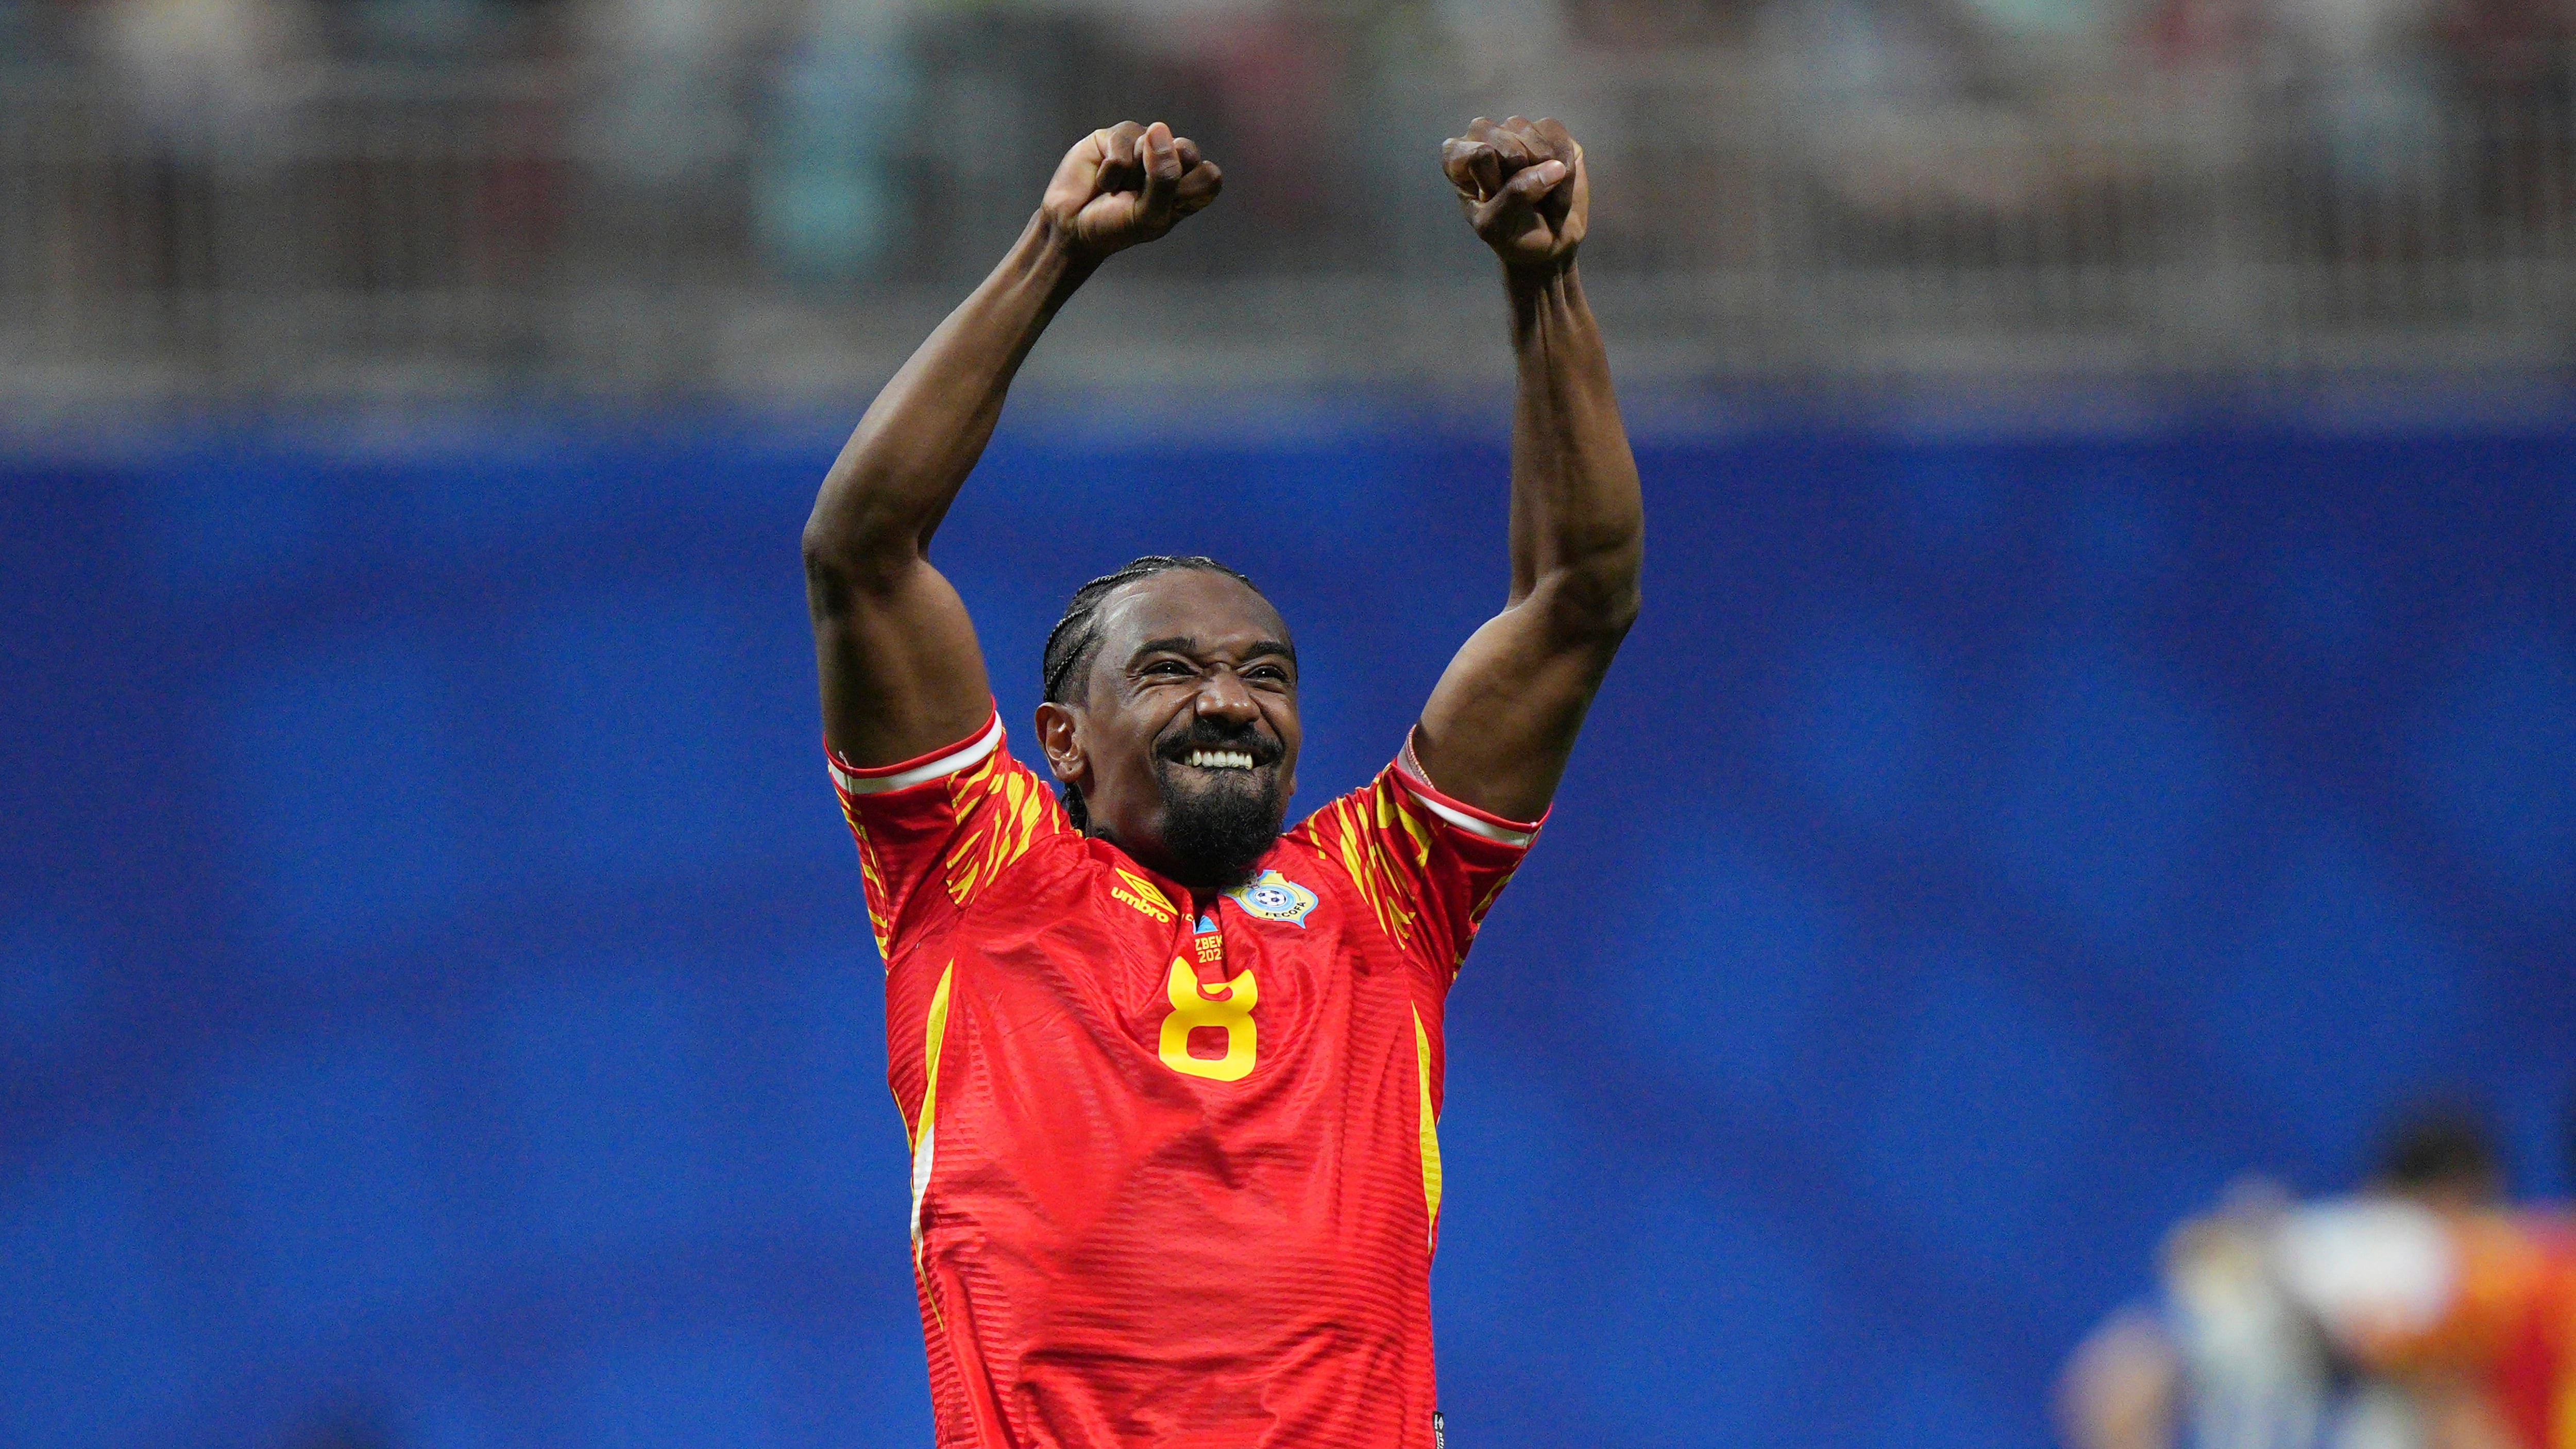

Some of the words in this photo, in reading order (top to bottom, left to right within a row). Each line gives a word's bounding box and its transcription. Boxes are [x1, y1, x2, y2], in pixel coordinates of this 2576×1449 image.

[1111, 886, 1170, 923] umbro
[1197, 948, 1224, 963] 202
[1159, 956, 1258, 1082] 8
